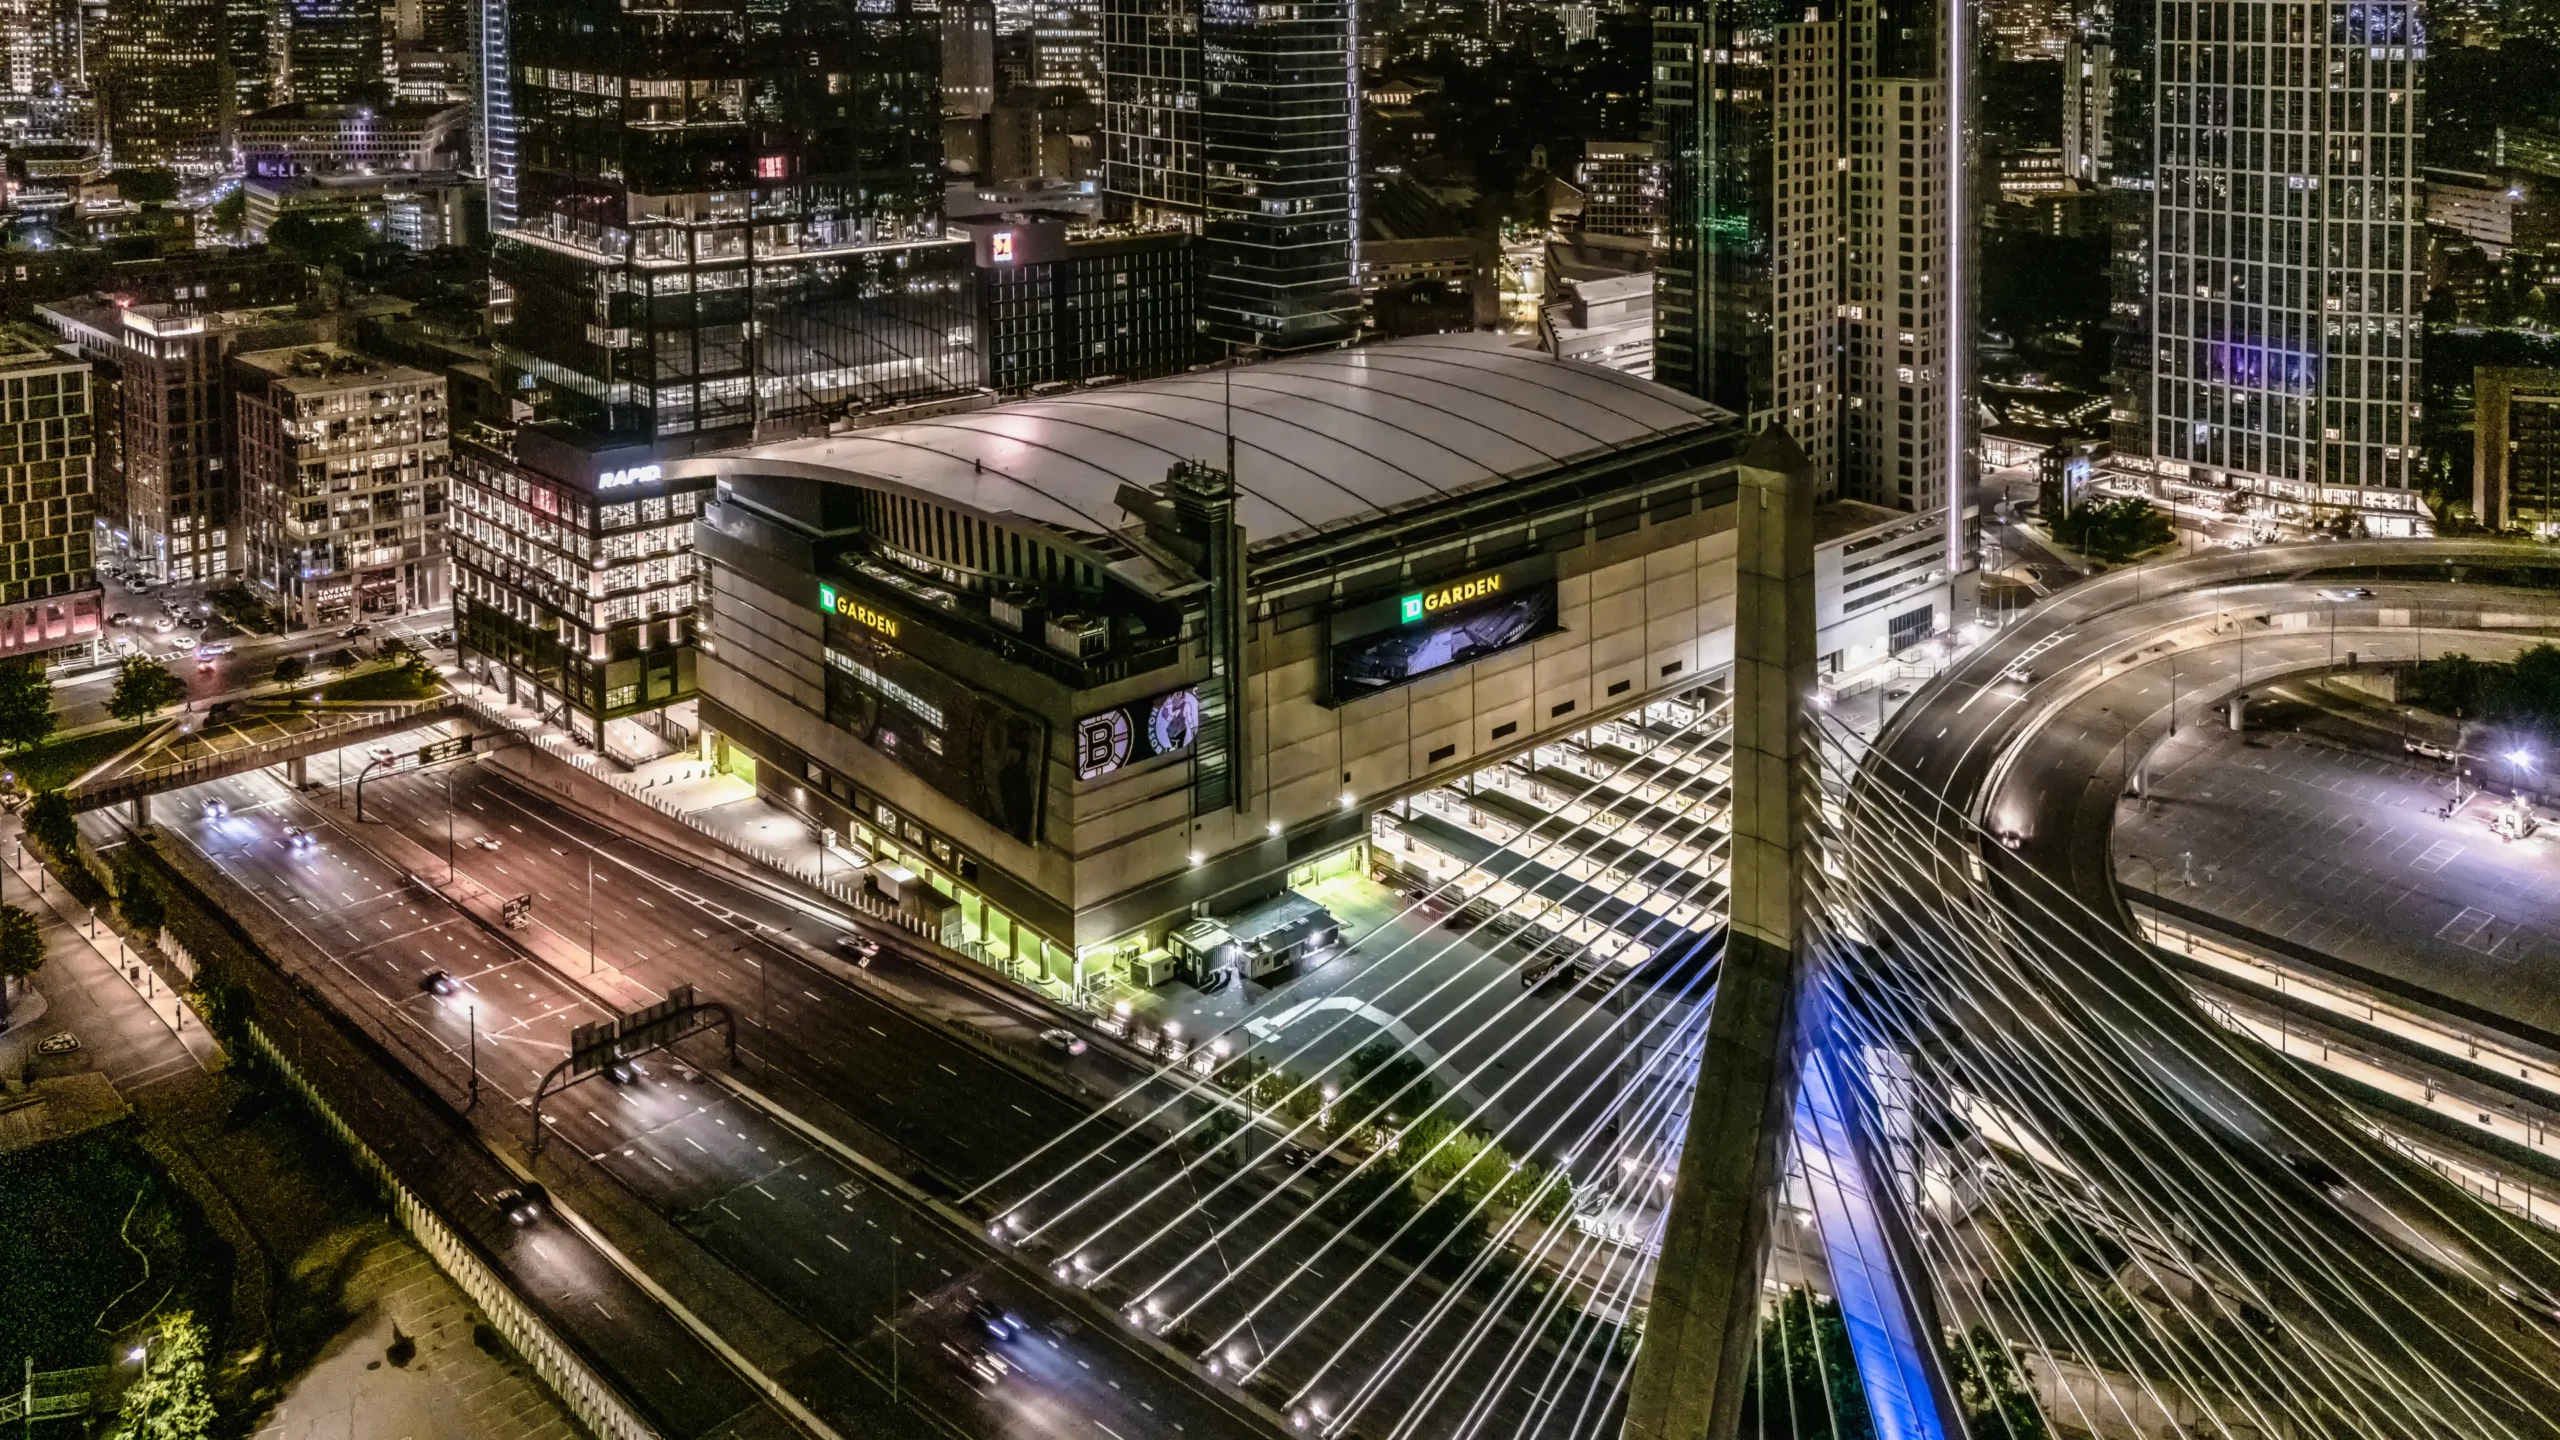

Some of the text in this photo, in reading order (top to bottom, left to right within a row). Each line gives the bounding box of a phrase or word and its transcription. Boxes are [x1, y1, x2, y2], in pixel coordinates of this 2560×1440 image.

[318, 585, 352, 597] TAVERN
[821, 588, 896, 638] TD GARDEN
[1403, 574, 1500, 618] TD GARDEN
[1084, 719, 1116, 771] B
[1148, 707, 1163, 755] BOSTON
